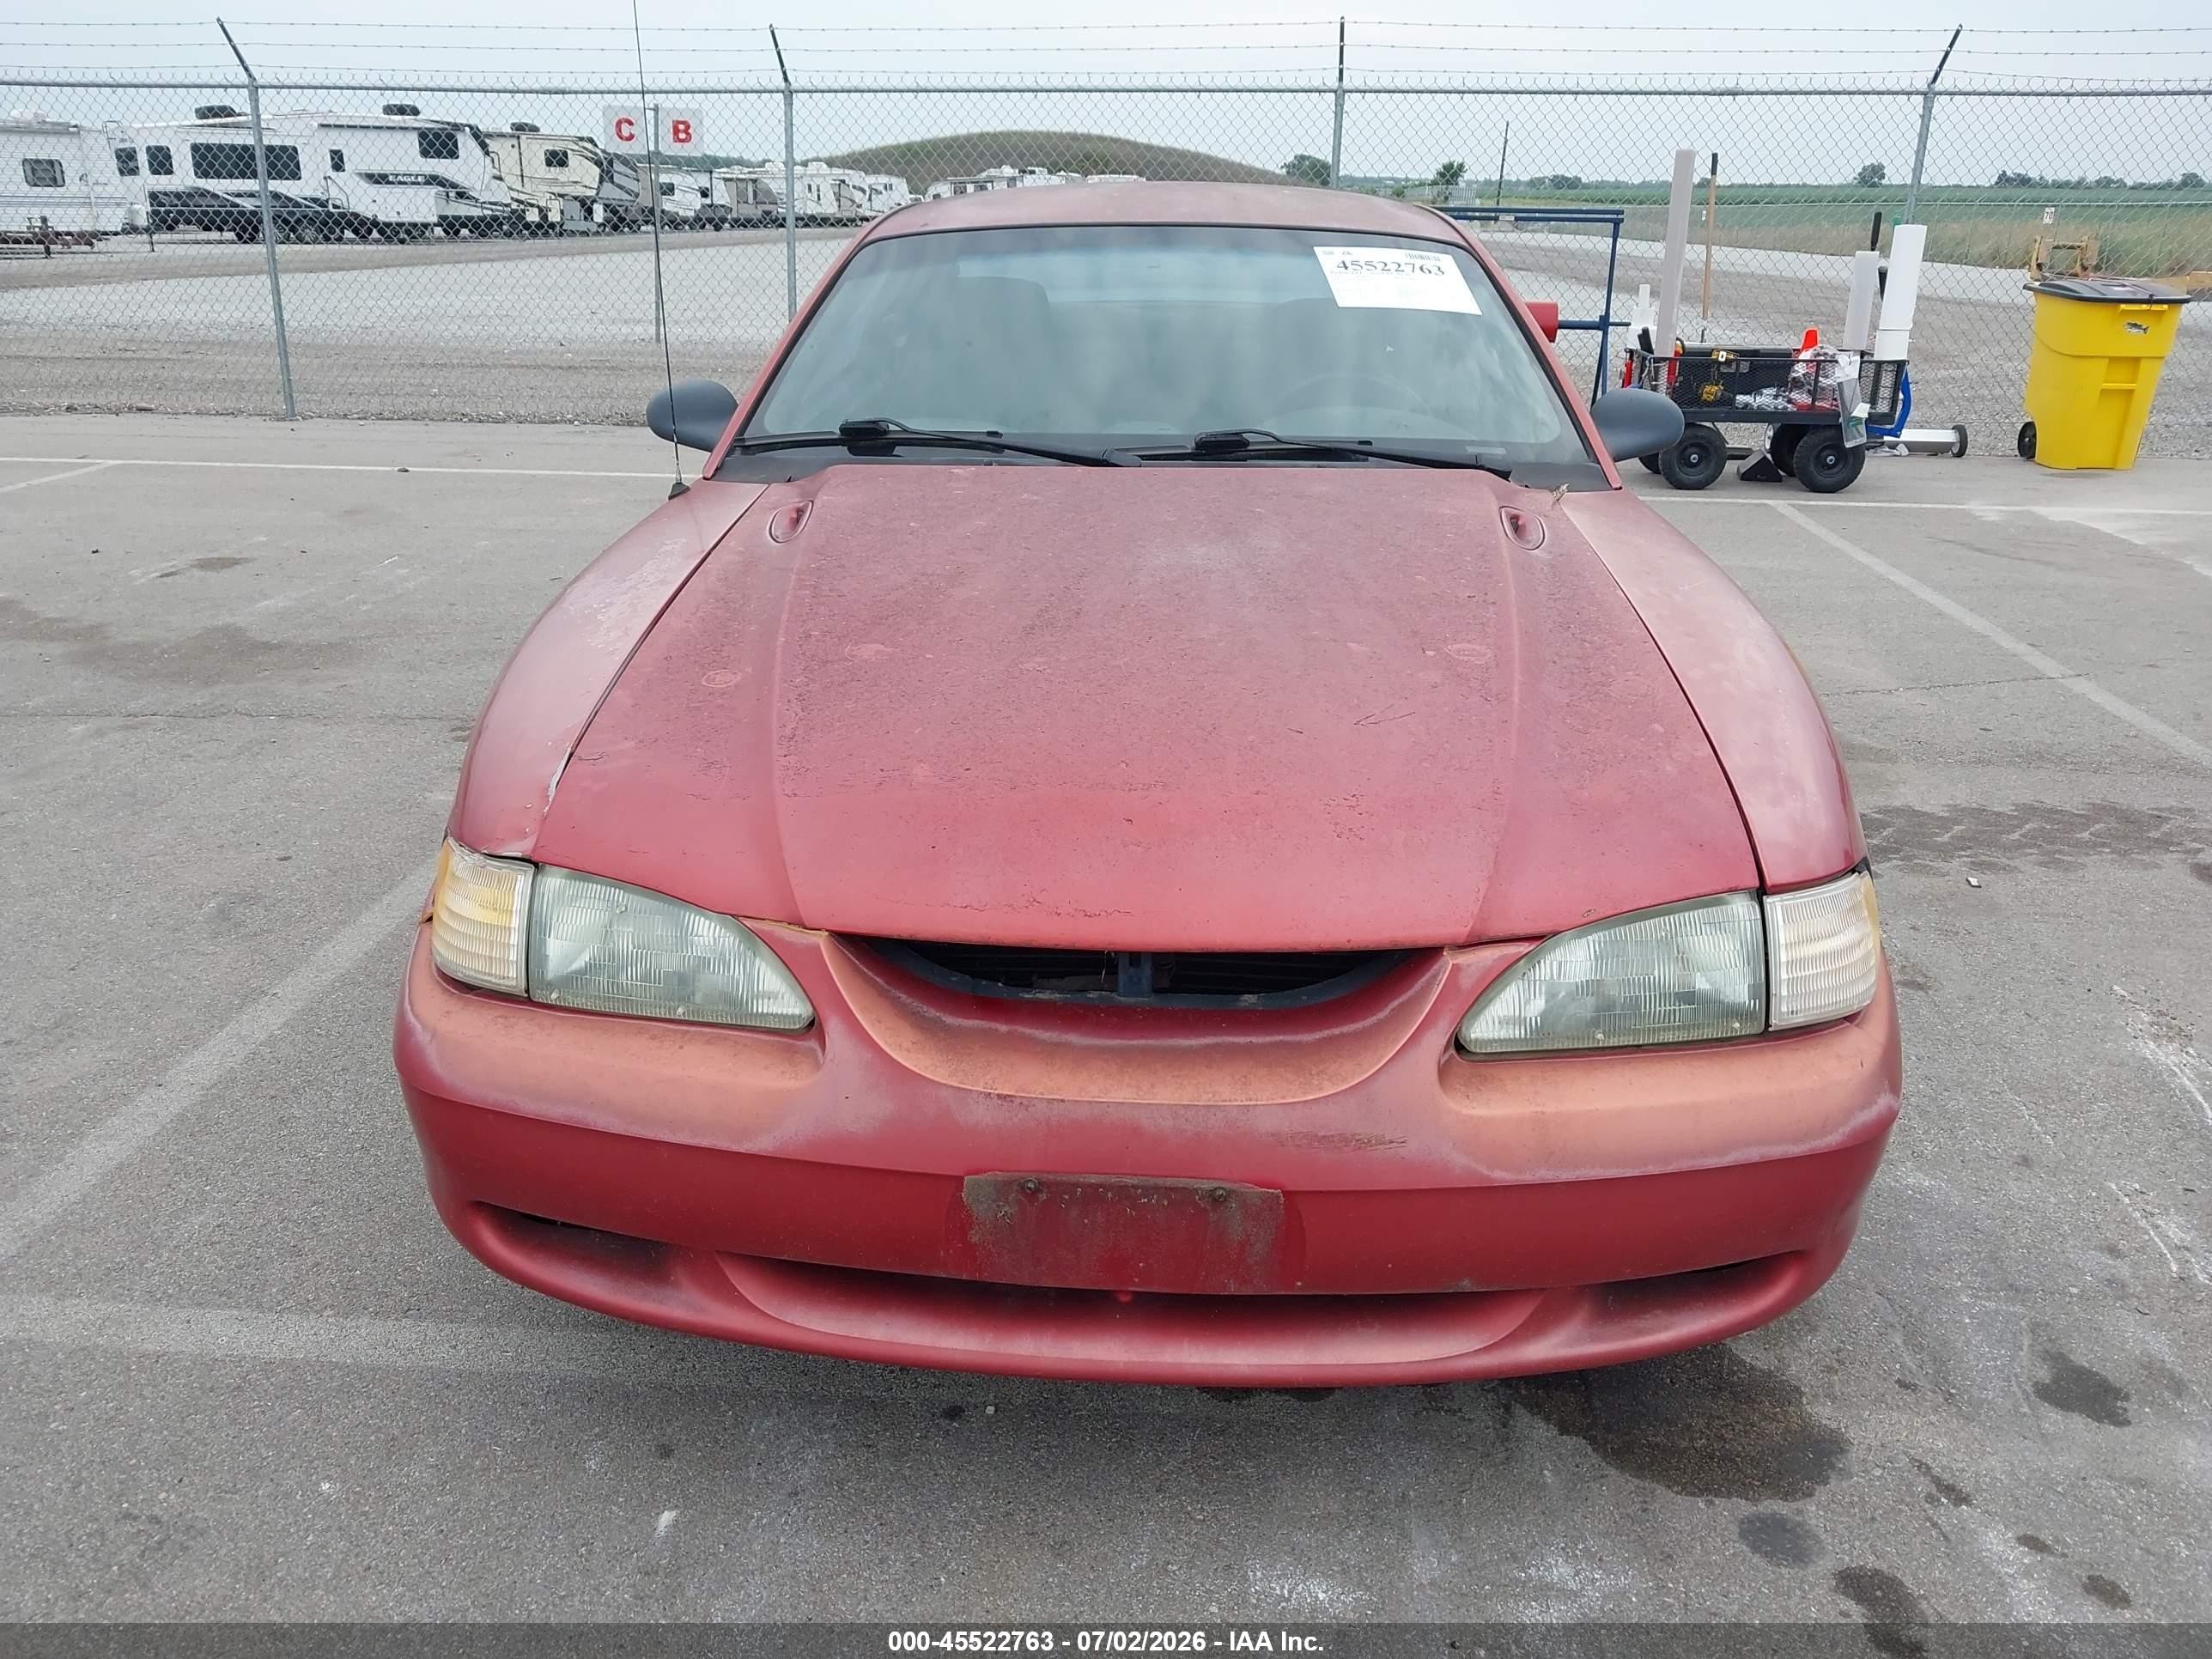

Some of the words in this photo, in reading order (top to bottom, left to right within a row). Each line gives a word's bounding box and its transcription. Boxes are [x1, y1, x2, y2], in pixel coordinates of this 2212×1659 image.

[615, 118, 635, 142] C
[672, 120, 692, 143] B
[1337, 260, 1445, 276] 45522763
